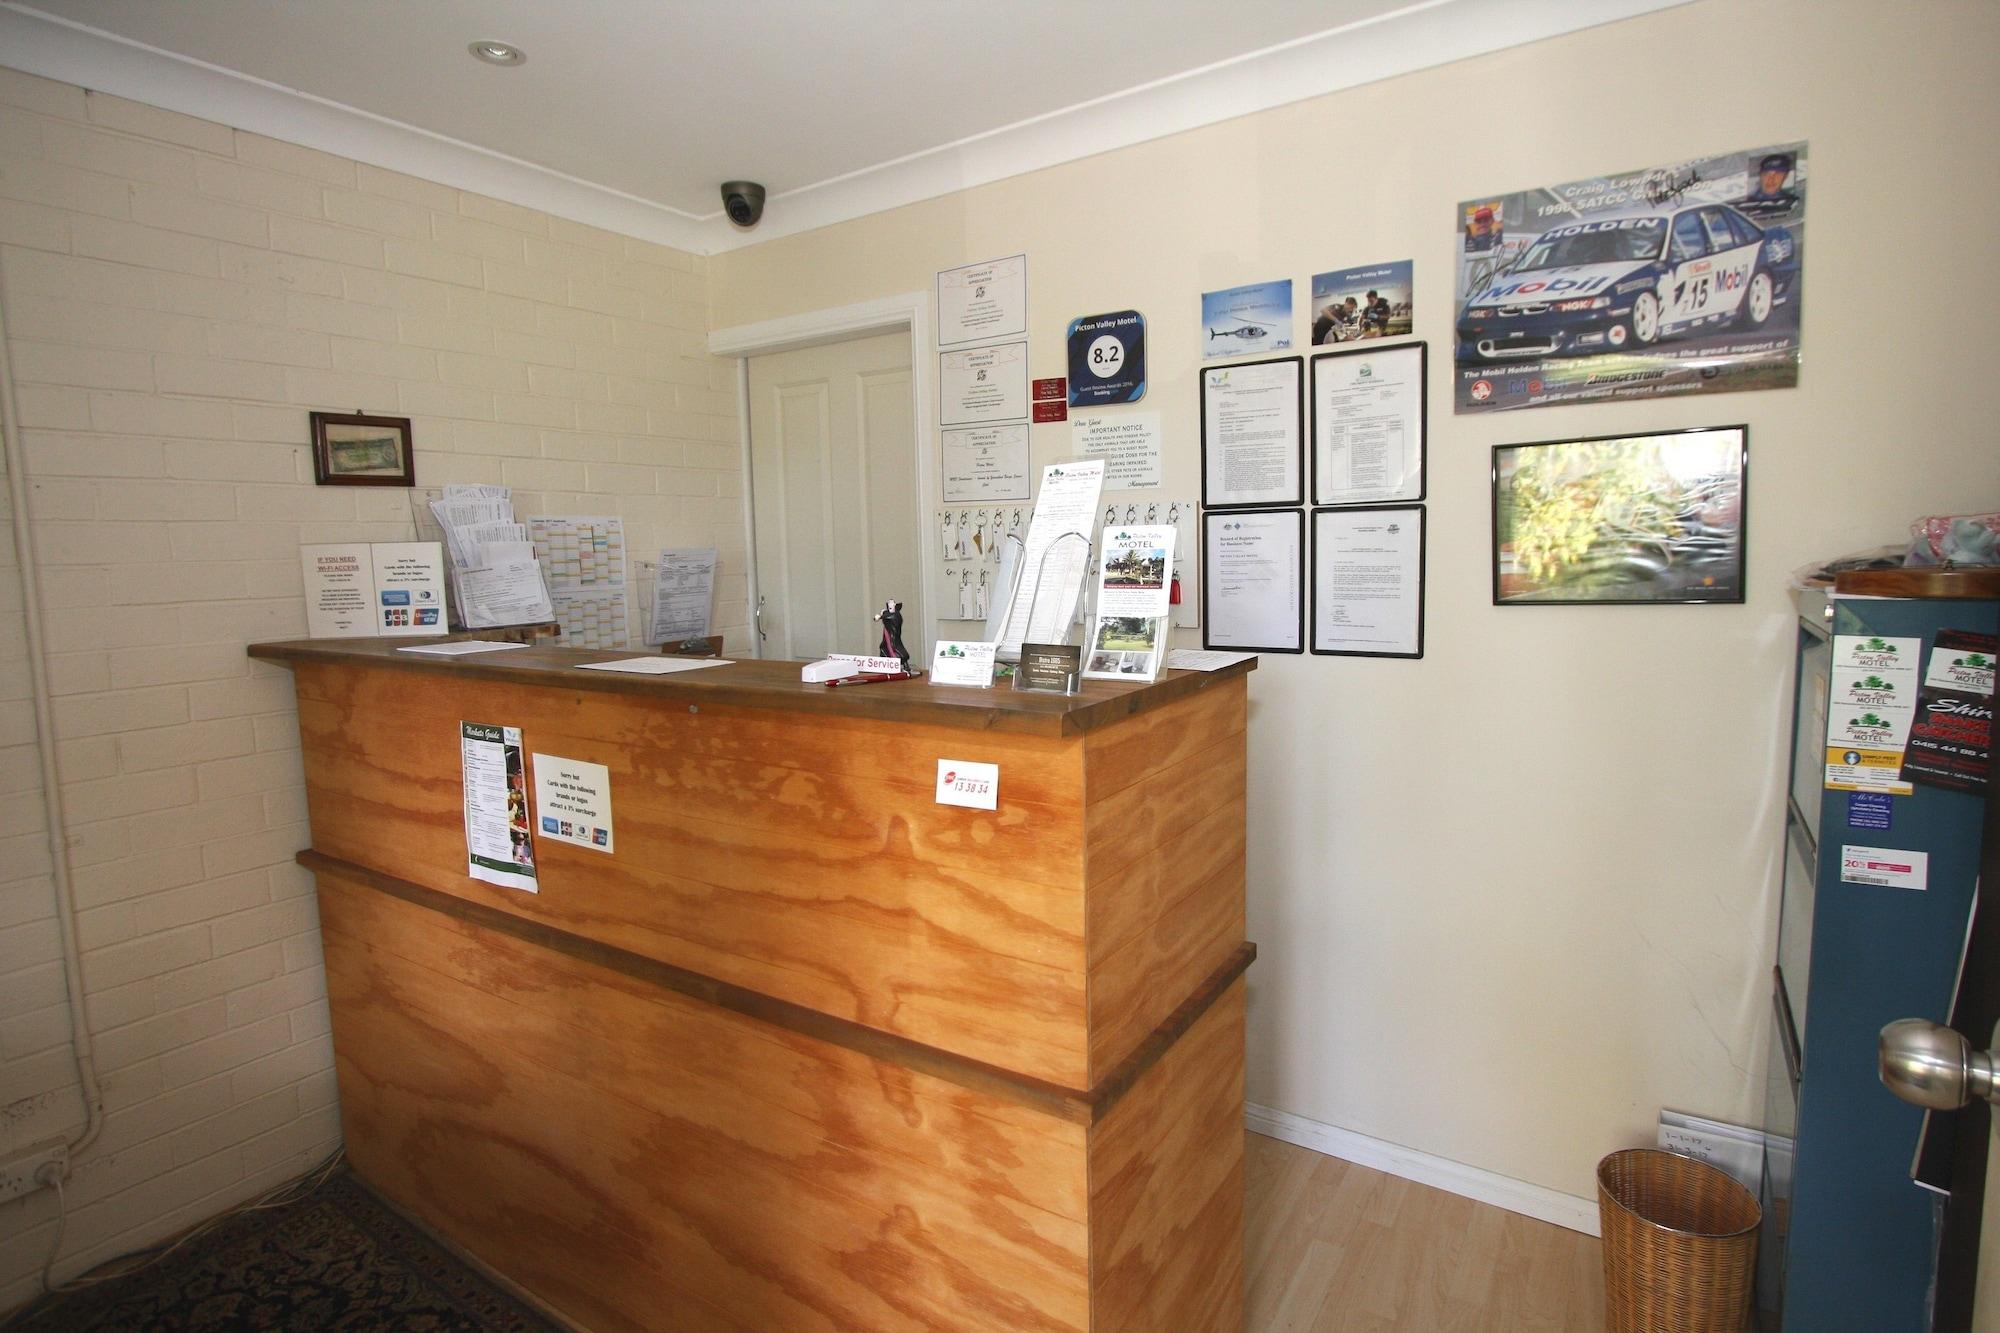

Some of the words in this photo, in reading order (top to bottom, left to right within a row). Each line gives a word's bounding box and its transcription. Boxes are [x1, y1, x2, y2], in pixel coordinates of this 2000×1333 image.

[1565, 182, 1605, 198] Craig
[1544, 218, 1660, 241] HOLDEN
[1714, 264, 1748, 293] Mobil
[1477, 276, 1609, 304] Mobil
[1075, 323, 1095, 332] Picton
[1096, 319, 1116, 329] Valley
[1117, 316, 1137, 325] Motel
[1731, 340, 1774, 354] support
[1094, 345, 1119, 364] 8.2
[1464, 371, 1480, 379] The
[1481, 367, 1506, 378] Mobil
[1508, 364, 1540, 374] Holden
[1585, 369, 1667, 386] BRIDGESTONE
[1089, 426, 1121, 434] IMPORTANT
[1122, 424, 1143, 432] NOTICE
[1118, 540, 1154, 549] MOTEL
[867, 657, 900, 670] Service
[1858, 659, 1890, 667] MOTEL
[1954, 675, 1987, 685] MOTEL
[1856, 697, 1888, 705] MOTEL
[485, 729, 500, 740] Guide
[1853, 734, 1885, 742] MOTEL
[954, 782, 964, 791] 13
[965, 783, 976, 793] 38
